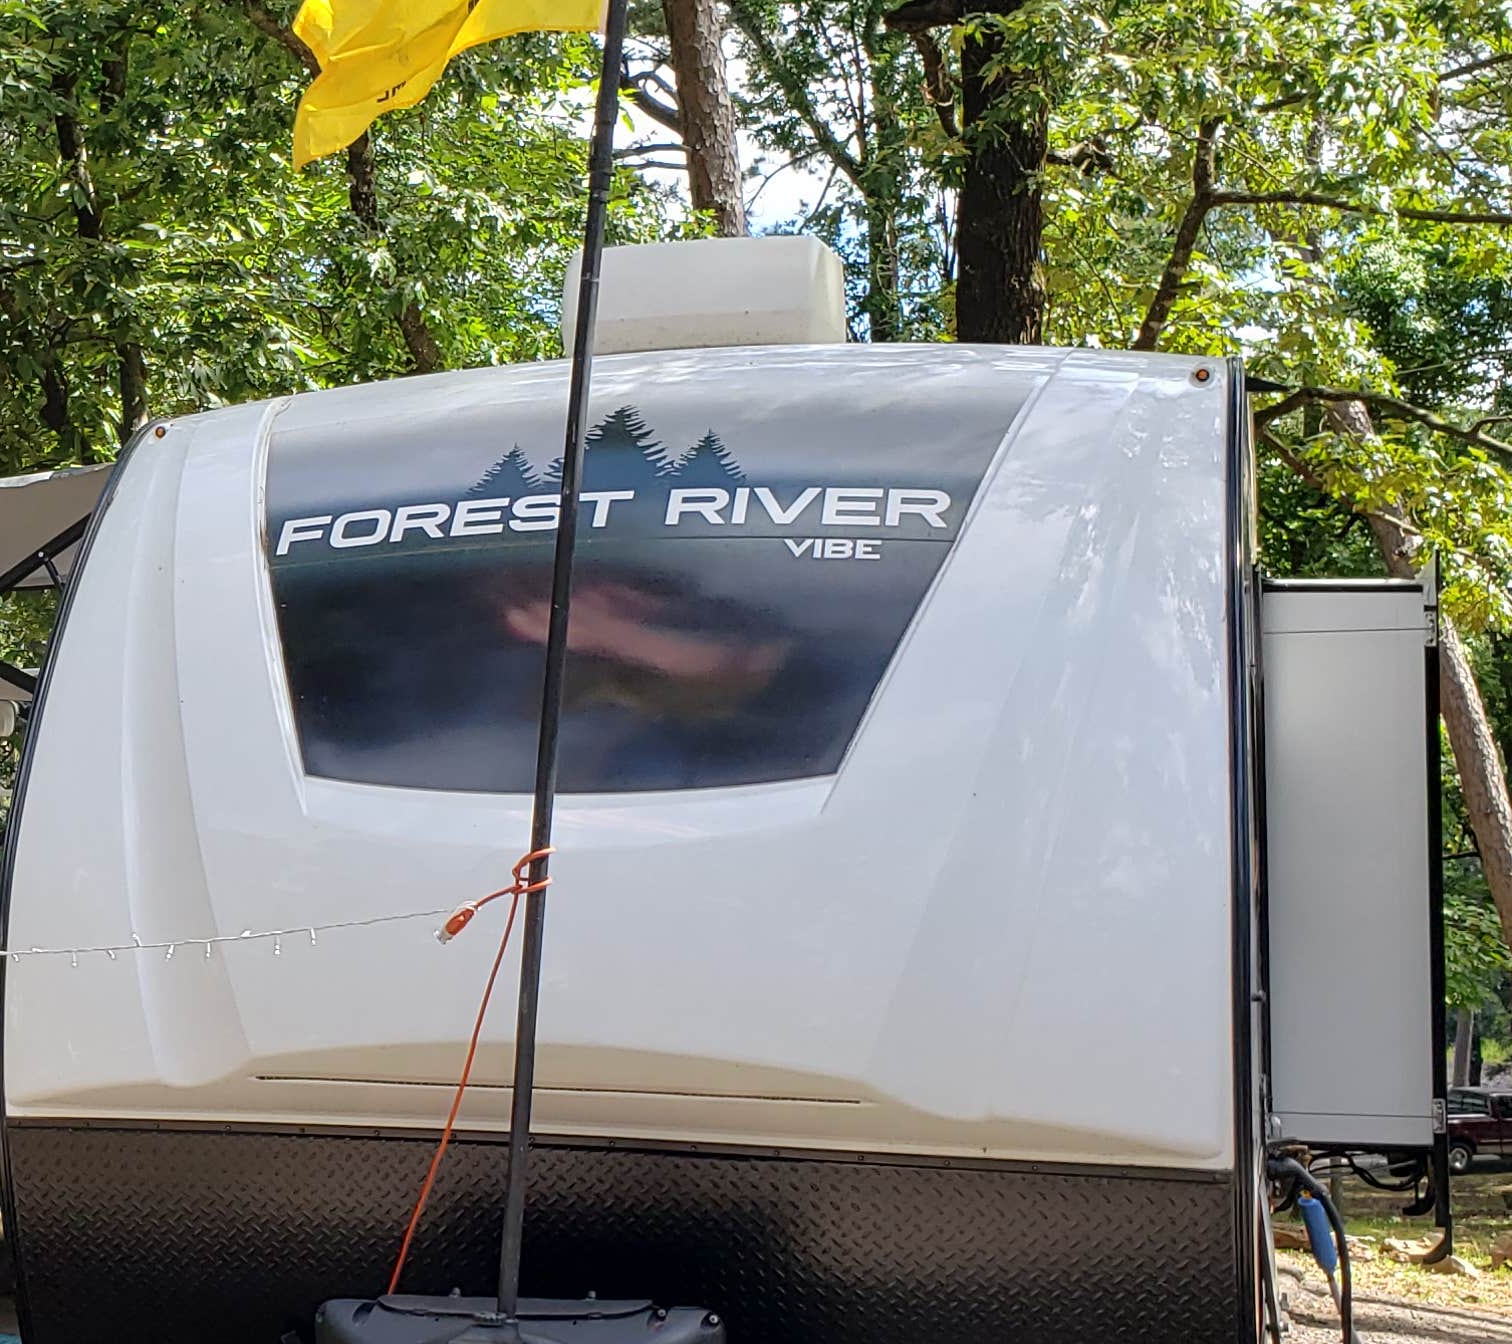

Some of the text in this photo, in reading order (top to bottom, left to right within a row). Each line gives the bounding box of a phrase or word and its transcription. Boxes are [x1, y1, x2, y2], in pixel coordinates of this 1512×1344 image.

[276, 487, 951, 556] FOREST RIVER
[784, 538, 882, 560] VIBE
